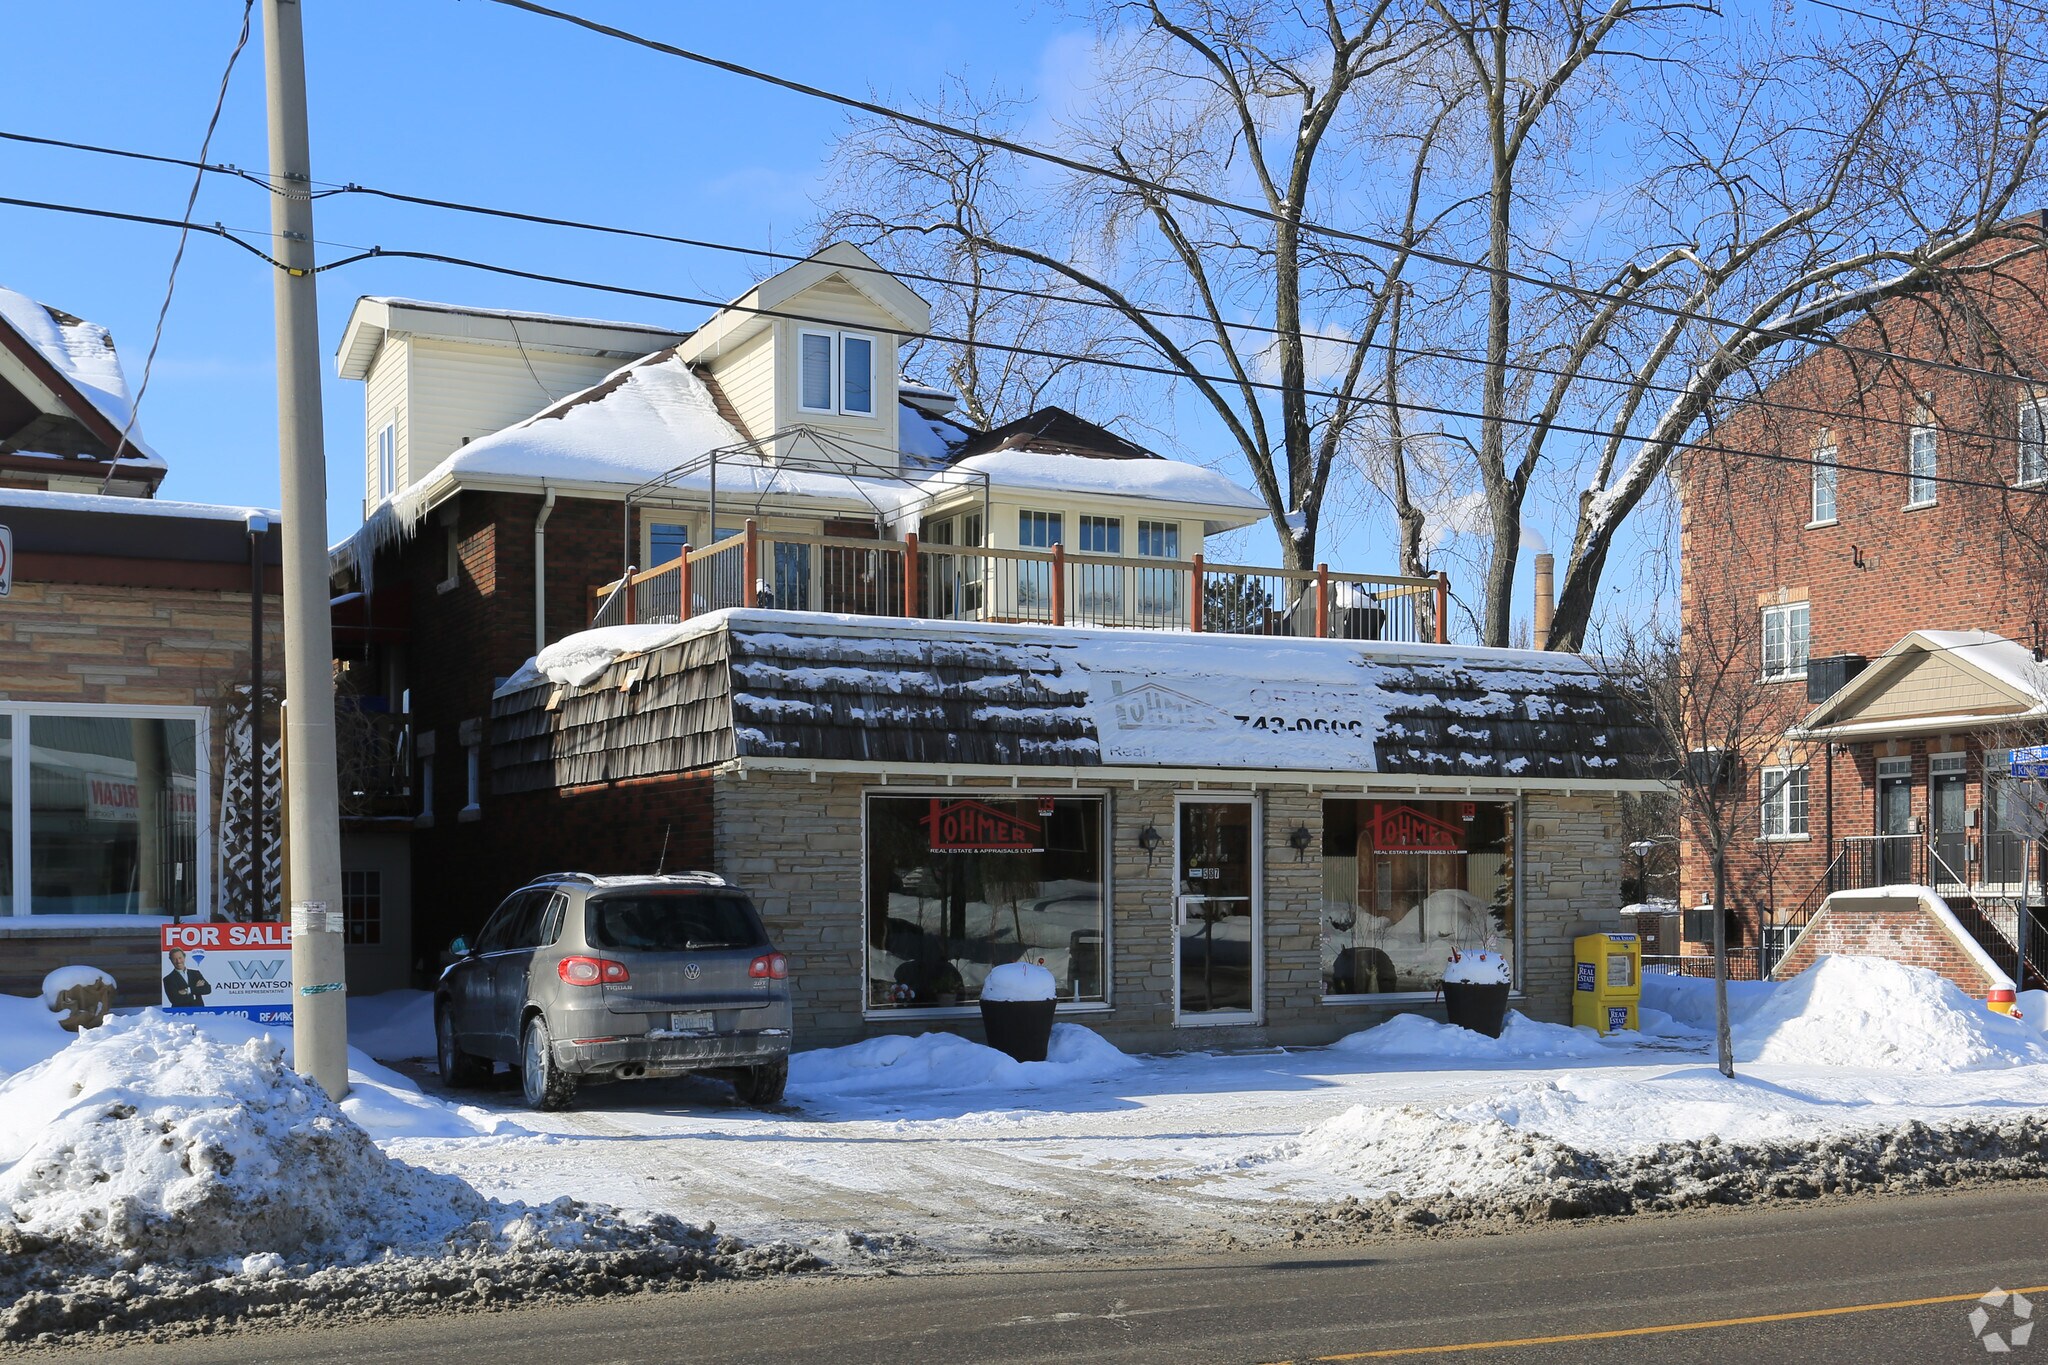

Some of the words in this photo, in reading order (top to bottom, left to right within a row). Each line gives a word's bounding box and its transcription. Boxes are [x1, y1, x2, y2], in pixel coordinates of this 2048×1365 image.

[930, 798, 1034, 849] LOHMER
[165, 926, 221, 946] FOR
[229, 926, 293, 945] SALE
[1579, 967, 1594, 976] REAL
[1577, 973, 1595, 983] ESTATE
[215, 981, 247, 990] ANDY
[248, 980, 294, 989] WATSON
